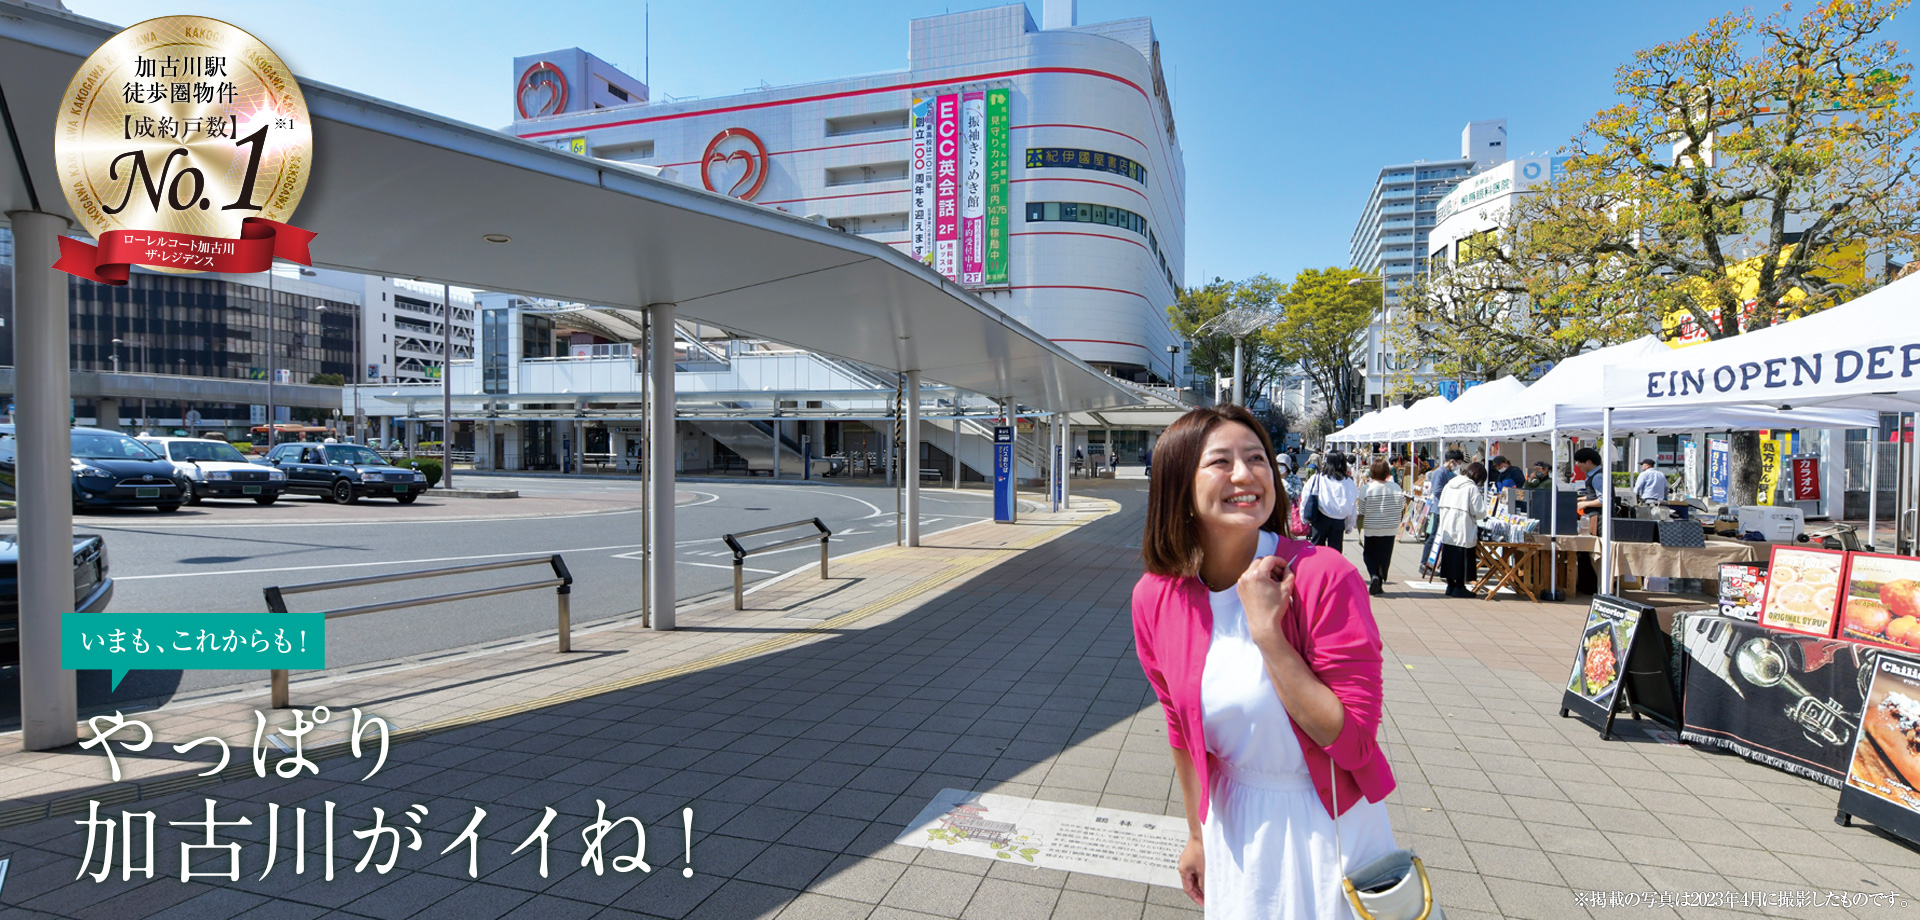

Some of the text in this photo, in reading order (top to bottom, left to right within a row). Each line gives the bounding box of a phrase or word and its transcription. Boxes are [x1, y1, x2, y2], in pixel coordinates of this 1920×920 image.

[573, 143, 584, 154] 6F
[938, 101, 956, 218] ECC英会話
[967, 115, 980, 208] 振袖きらめき館
[1045, 150, 1128, 173] 紀伊國屋書店
[939, 224, 955, 235] 2F
[966, 273, 979, 282] 2F
[1646, 367, 1705, 397] EIN
[1713, 353, 1822, 393] OPEN
[1799, 460, 1814, 496] カラオケ
[1594, 603, 1625, 619] Tacorice
[1768, 612, 1828, 628] ORIGINAL SYRUP
